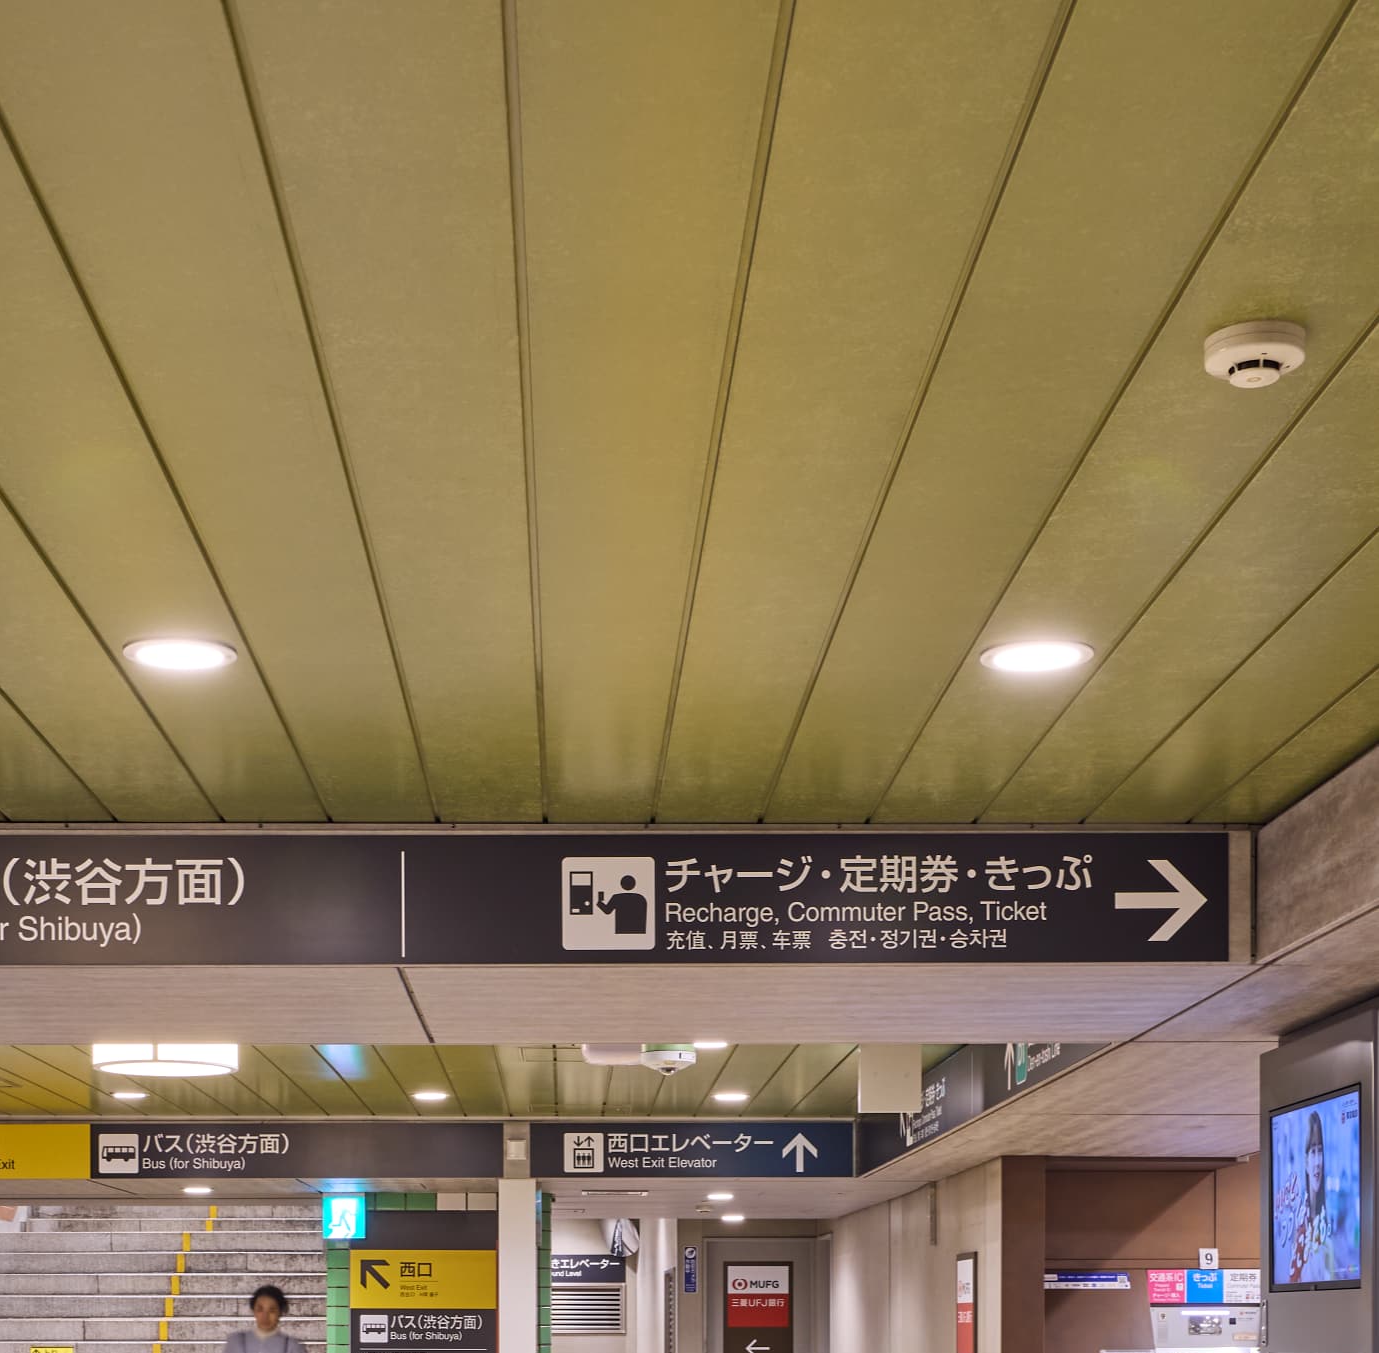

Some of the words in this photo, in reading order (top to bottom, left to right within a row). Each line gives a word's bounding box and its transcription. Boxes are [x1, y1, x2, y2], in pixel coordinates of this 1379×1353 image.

[665, 854, 1093, 894] チャージ・定期券・きっぷ
[665, 902, 780, 928] Recharge,
[787, 902, 907, 924] Commuter
[913, 902, 974, 927] Pass,
[979, 901, 1047, 924] Ticket
[18, 913, 142, 948] Shibuya)
[142, 1133, 290, 1155] バス（渋谷方面）
[607, 1133, 774, 1154] 西口エレベーター
[142, 1158, 166, 1169] Bus
[169, 1157, 190, 1172] (for
[192, 1156, 246, 1172] Shibuya)
[607, 1157, 639, 1169] West
[642, 1156, 665, 1169] Exit
[668, 1156, 718, 1169] Elevator
[1205, 1253, 1213, 1266] 9
[399, 1261, 433, 1278] 西口
[1230, 1272, 1258, 1282] 定期券
[749, 1280, 780, 1289] MUFG
[1192, 1272, 1218, 1283] きっぷ
[390, 1315, 483, 1330] バス（渋谷方面）
[390, 1331, 408, 1341] Bus
[409, 1331, 423, 1342] (for
[426, 1331, 463, 1342] Shibuya)
